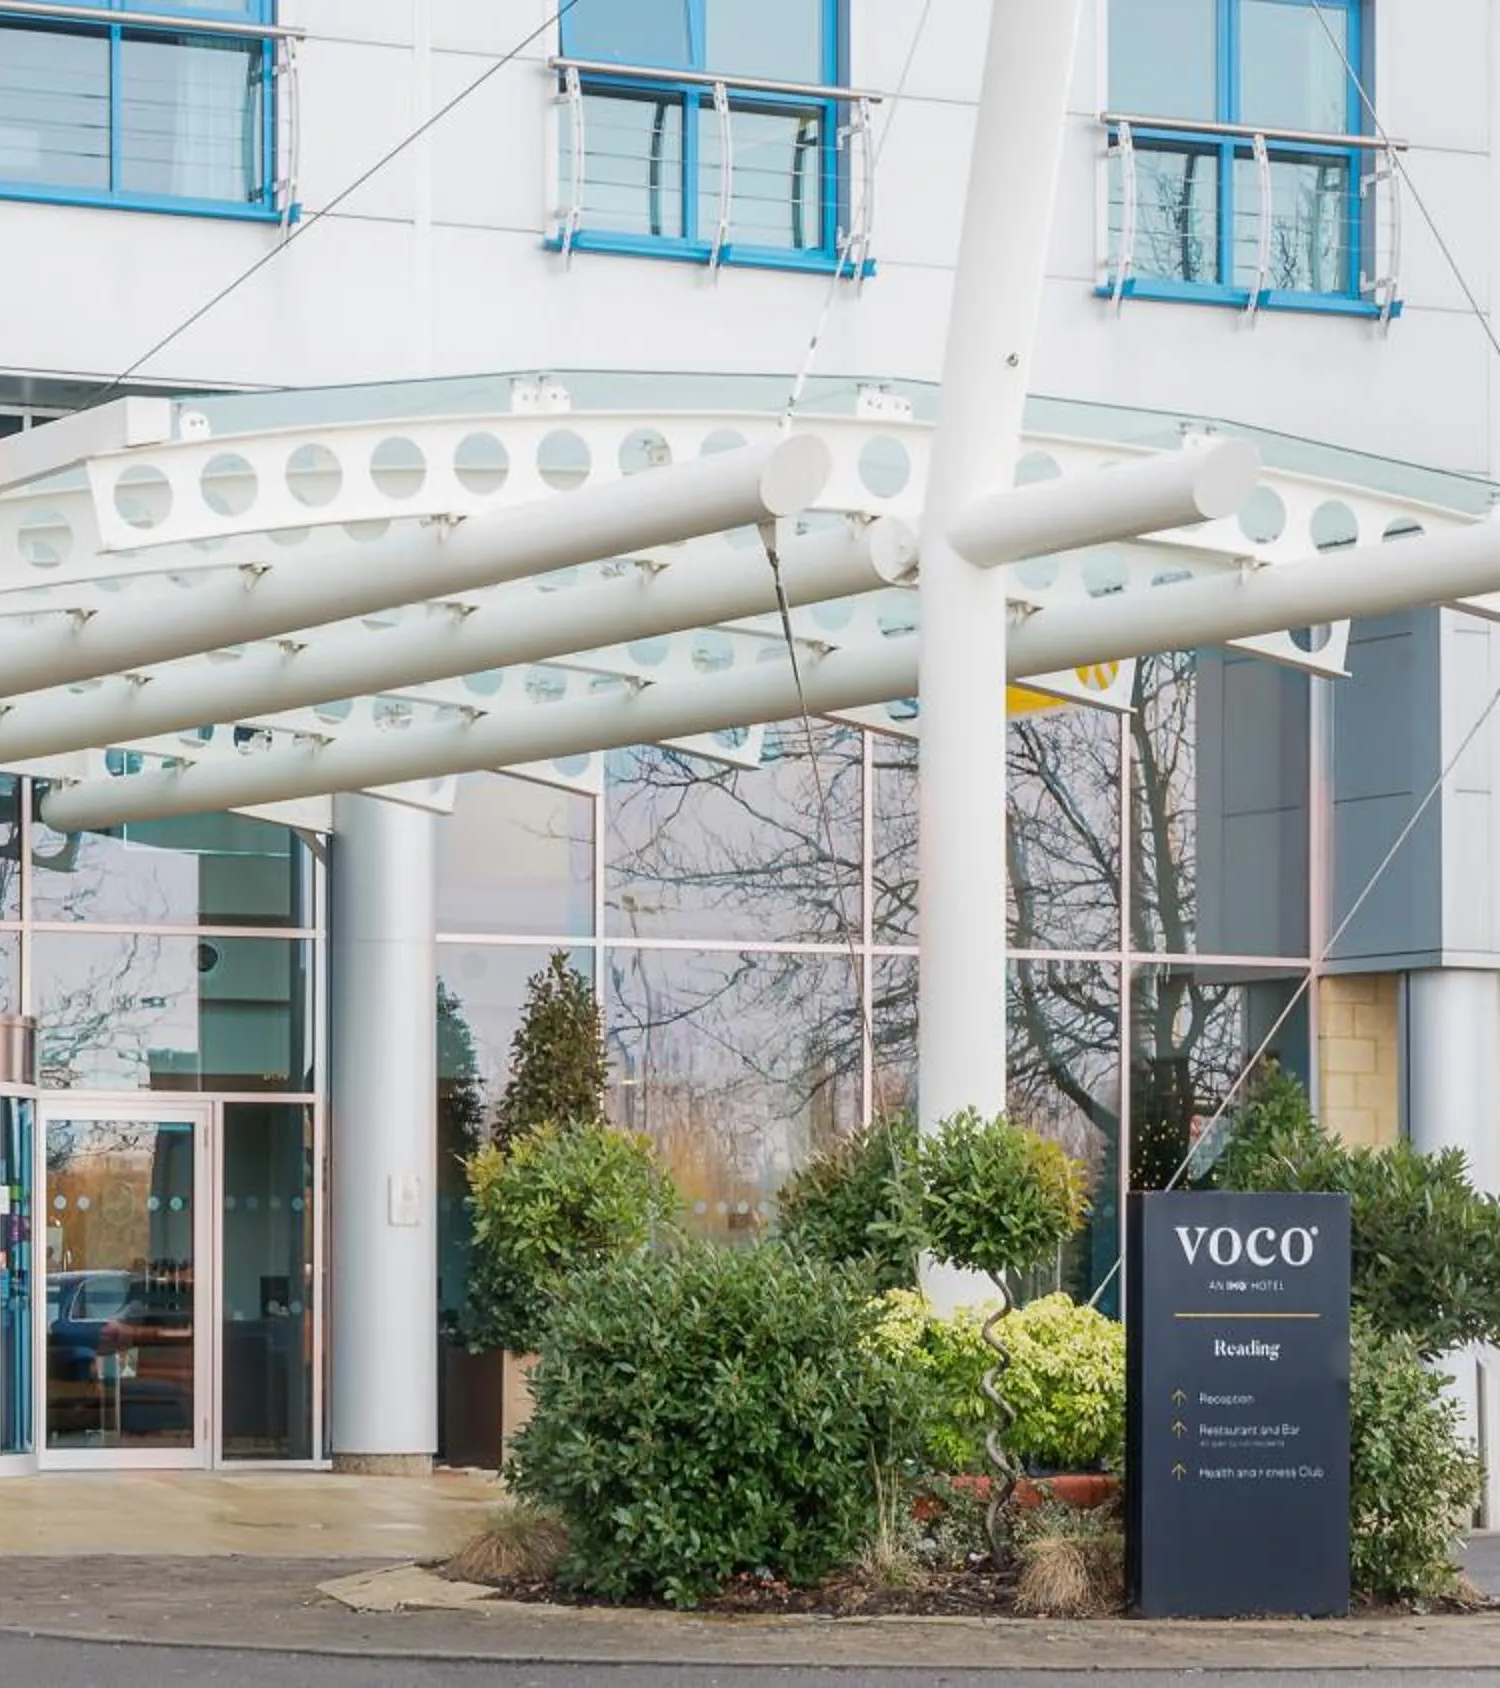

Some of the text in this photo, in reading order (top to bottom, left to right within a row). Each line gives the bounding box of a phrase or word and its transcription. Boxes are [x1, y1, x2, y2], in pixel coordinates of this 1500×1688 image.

[1208, 1279, 1224, 1292] AN
[1251, 1279, 1285, 1291] HOTEL
[1213, 1339, 1281, 1361] Reading
[1199, 1391, 1255, 1406] Reception
[1199, 1423, 1258, 1436] Restaurant
[1260, 1424, 1280, 1436] and
[1199, 1465, 1235, 1479] Health
[1299, 1464, 1325, 1479] Club
